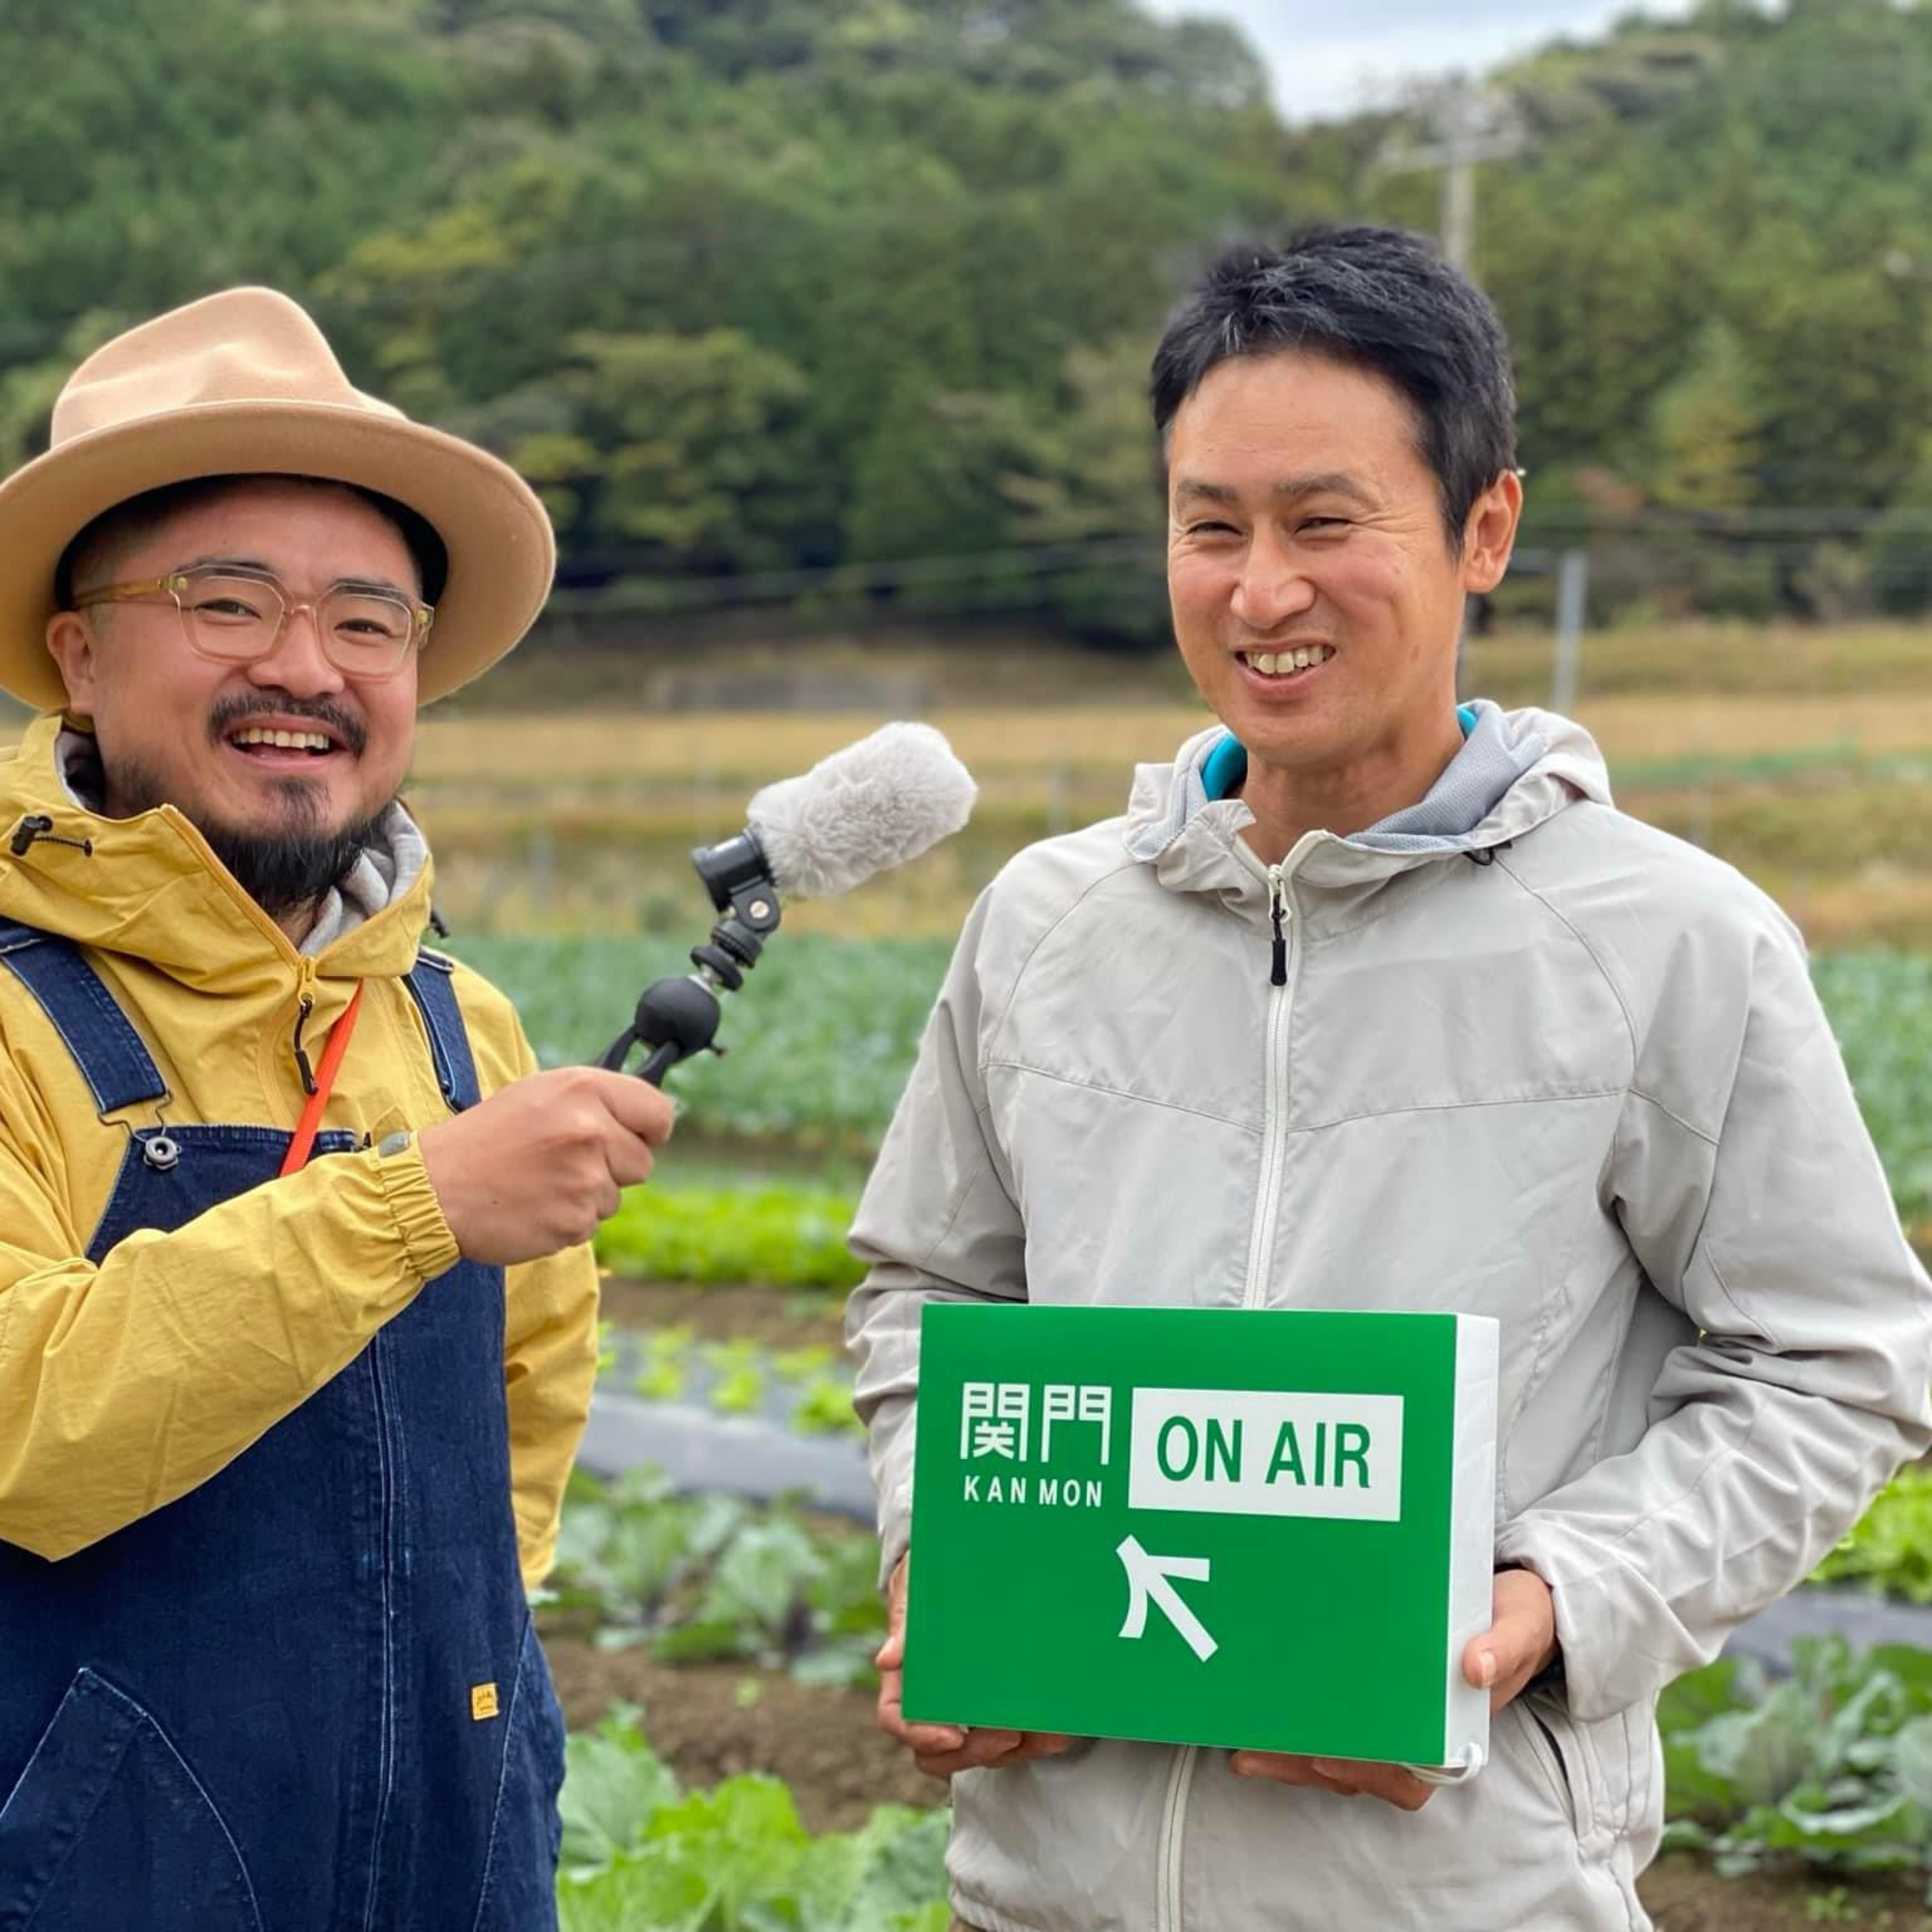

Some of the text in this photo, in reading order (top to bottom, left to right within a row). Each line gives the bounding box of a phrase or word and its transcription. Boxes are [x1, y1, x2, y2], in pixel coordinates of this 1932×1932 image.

[960, 1382, 1112, 1465] 関門
[1157, 1416, 1371, 1488] ON AIR
[964, 1475, 1102, 1507] KAN MON
